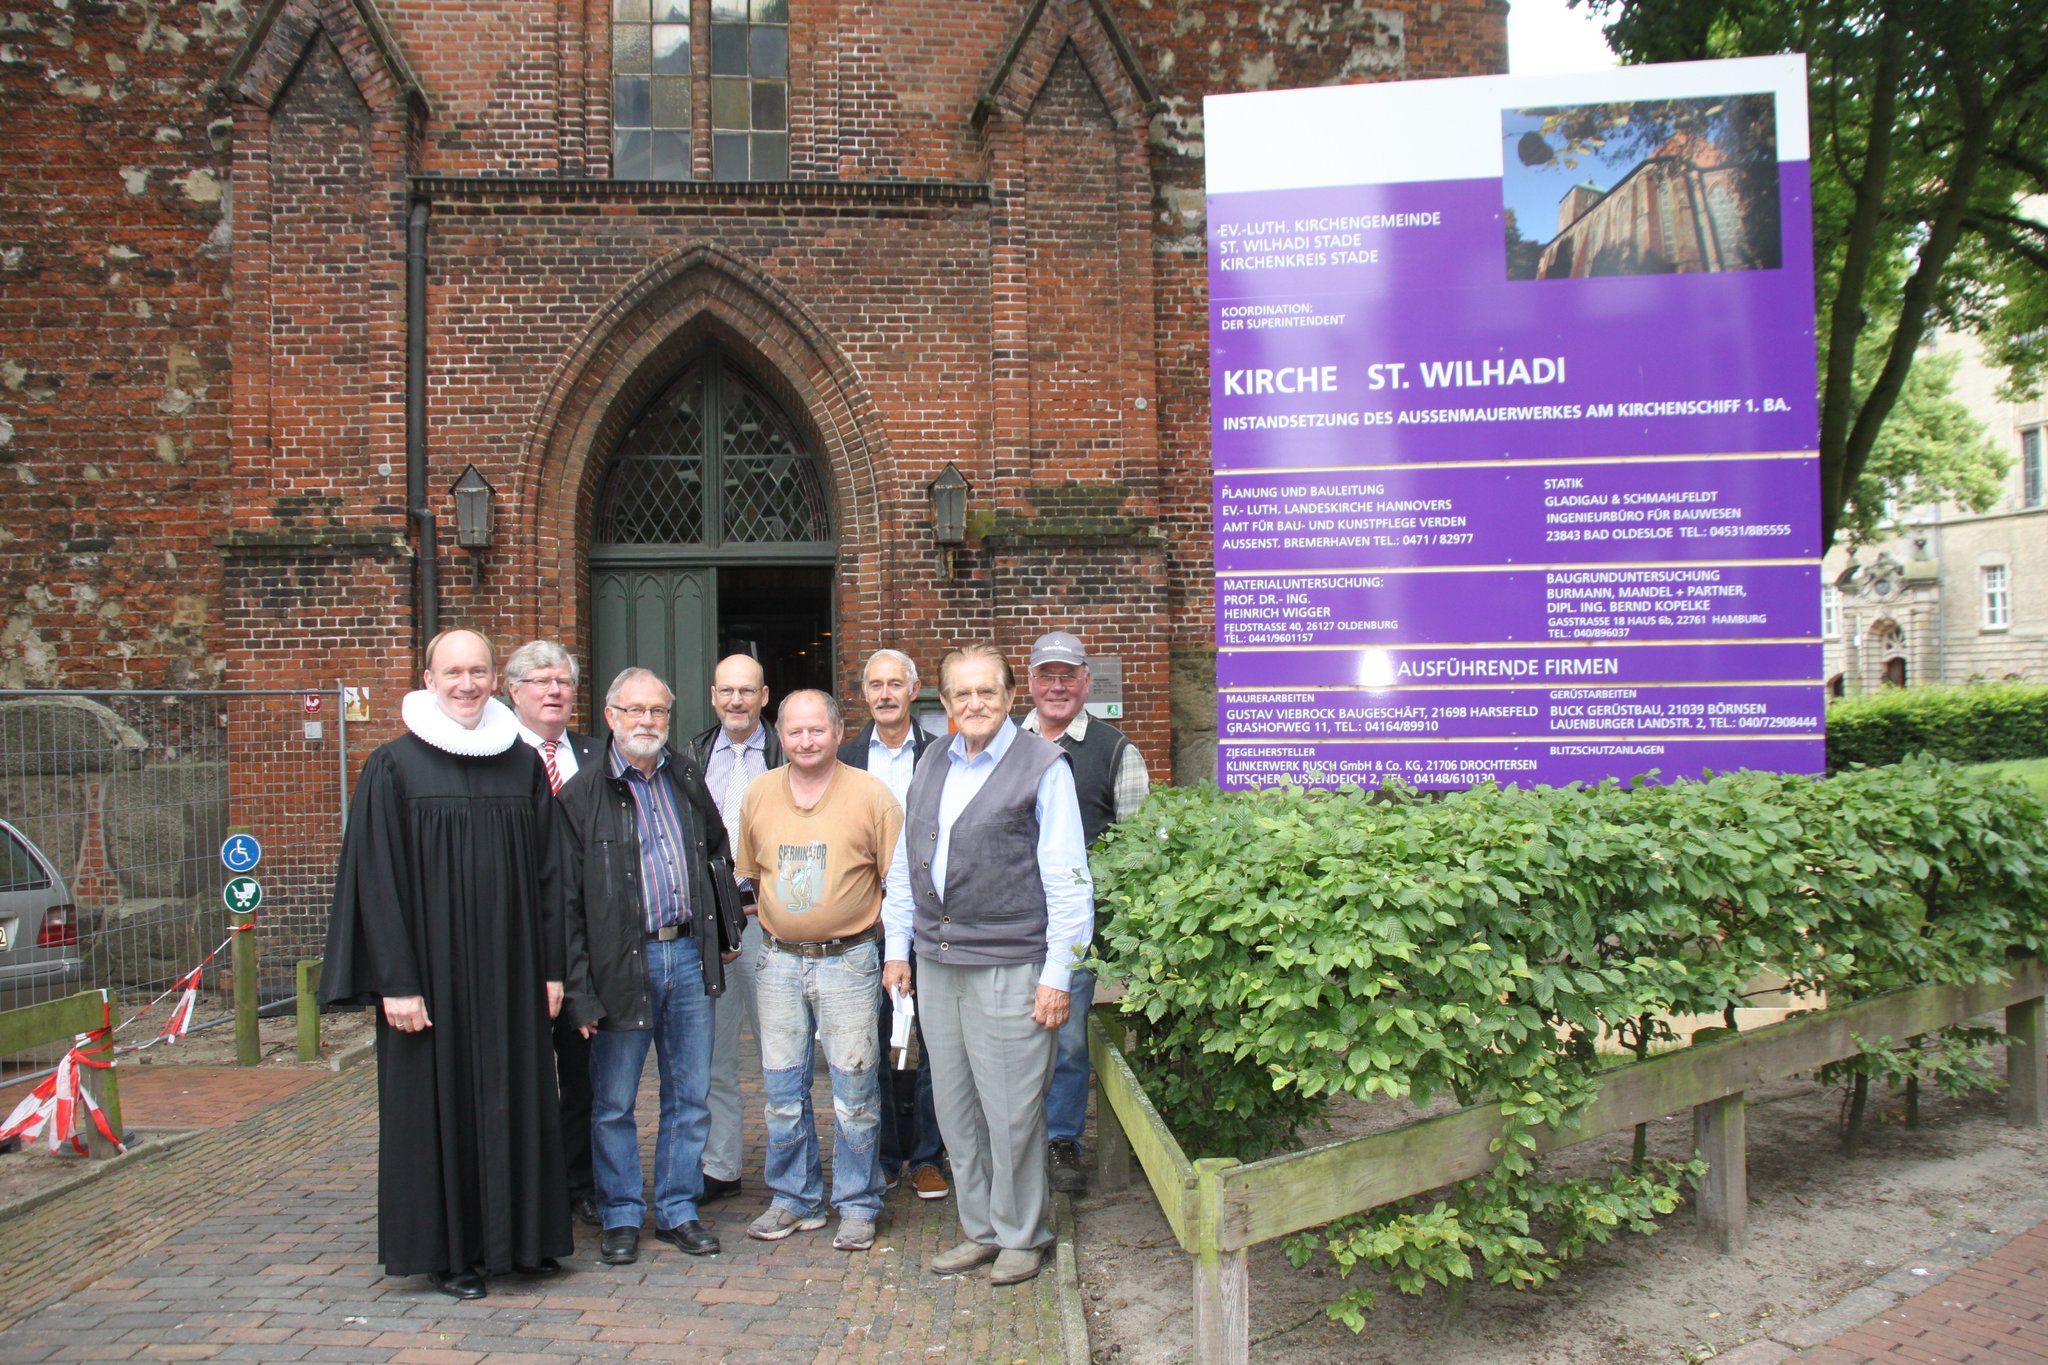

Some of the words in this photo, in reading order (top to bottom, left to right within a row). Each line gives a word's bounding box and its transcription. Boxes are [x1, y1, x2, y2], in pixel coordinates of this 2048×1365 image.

[1220, 220, 1290, 237] EV.-LUTH.
[1295, 212, 1441, 233] KIRCHENGEMEINDE
[1220, 241, 1240, 254] ST.
[1243, 237, 1309, 252] WILHADI
[1314, 233, 1361, 248] STADE
[1221, 253, 1327, 271] KIRCHENKREIS
[1331, 249, 1379, 265] STADE
[1222, 303, 1313, 317] KOORDINATION:
[1222, 319, 1244, 330] DER
[1247, 314, 1345, 329] SUPERINTENDENT
[1224, 366, 1337, 396] KIRCHE
[1367, 363, 1410, 391] ST.
[1419, 356, 1565, 388] WILHADI
[1223, 412, 1359, 430] INSTANDSETZUNG
[1364, 411, 1393, 426] DES
[1397, 404, 1582, 424] AUSSENMAUERWERKES
[1586, 404, 1613, 418] AM
[1618, 399, 1741, 417] KIRCHENSCHIFF
[1746, 399, 1759, 413] 1.
[1763, 398, 1791, 412] BA.
[1544, 478, 1584, 490] STATIK
[1222, 487, 1277, 499] PLANUNG
[1281, 487, 1307, 498] UND
[1310, 484, 1384, 496] BAULEITUNG
[1545, 495, 1608, 507] GLADIGAU
[1612, 494, 1621, 505] &
[1623, 491, 1718, 505] SCHMAHLFELDT
[1247, 504, 1281, 515] LUTH.
[1285, 501, 1373, 514] LANDESKIRCHE
[1377, 499, 1452, 512] HANNOVERS
[1546, 509, 1644, 524] INGENIEURBÜRO
[1647, 508, 1670, 521] FÜR
[1673, 508, 1742, 520] BAUWESEN
[1223, 522, 1249, 533] AMT
[1252, 519, 1274, 531] FÜR
[1277, 520, 1306, 531] BAU-
[1309, 519, 1334, 530] UND
[1338, 518, 1416, 529] KUNSTPFLEGE
[1420, 516, 1466, 528] VERDEN
[1546, 531, 1581, 542] 23843
[1584, 530, 1609, 541] BAD
[1612, 527, 1673, 539] OLDESLOE
[1680, 527, 1707, 538] TEL.:
[1710, 524, 1791, 537] 04531/885555
[1222, 538, 1281, 549] AUSSENST.
[1284, 536, 1370, 548] BREMERHAVEN
[1374, 535, 1399, 546] TEL.:
[1403, 535, 1429, 545] 0471
[1440, 533, 1473, 544] 82977
[1224, 577, 1384, 590] MATERIALUNTERSUCHUNG:
[1546, 570, 1720, 584] BAUGRUNDUNTERSUCHUNG
[1224, 595, 1256, 605] PROF.
[1286, 594, 1311, 604] ING.
[1547, 587, 1615, 600] BURMANN,
[1619, 586, 1672, 598] MANDEL
[1676, 588, 1684, 596] +
[1687, 585, 1747, 598] PARTNER,
[1224, 608, 1279, 619] HEINRICH
[1282, 607, 1331, 618] WIGGER
[1547, 602, 1577, 613] DIPL.
[1580, 601, 1607, 613] ING.
[1610, 601, 1651, 612] BERND
[1655, 600, 1710, 611] KOPELKE
[1224, 622, 1287, 632] FELDSTRASSE
[1290, 622, 1303, 632] 40,
[1306, 622, 1334, 631] 26127
[1338, 620, 1398, 630] OLDENBURG
[1548, 616, 1610, 627] GASSTRASSE
[1614, 616, 1625, 626] 18
[1627, 616, 1656, 626] HAUS
[1659, 615, 1673, 626] 6b,
[1676, 615, 1706, 625] 22761
[1712, 614, 1767, 624] HAMBURG
[1224, 634, 1246, 643] TEL.:
[1248, 633, 1313, 643] 0441/9601157
[1548, 628, 1571, 638] TEL.:
[1574, 627, 1630, 638] 040/896037
[1398, 657, 1539, 677] AUSFÜHRENDE
[1545, 658, 1618, 675] FIRMEN
[1226, 694, 1315, 703] MAURERARBEITEN
[1550, 689, 1637, 700] GERÜSTARBEITEN
[1226, 709, 1273, 720] GUSTAV
[1276, 708, 1335, 720] VIEBROCK
[1339, 706, 1428, 720] BAUGESCHÄFT,
[1431, 707, 1467, 718] 21698
[1470, 706, 1539, 718] HARSEFELD
[1550, 706, 1584, 717] BUCK
[1587, 703, 1665, 717] GERÜSTBAU,
[1668, 704, 1704, 715] 21039
[1707, 702, 1766, 715] BÖRNSEN
[1226, 721, 1311, 733] GRASHOFWEG
[1314, 722, 1331, 734] 11,
[1334, 721, 1362, 732] TEL.:
[1365, 720, 1439, 732] 04164/89910
[1550, 718, 1634, 730] LAUENBURGER
[1638, 718, 1693, 729] LANDSTR.
[1696, 718, 1707, 730] 2,
[1710, 717, 1736, 728] TEL.:
[1739, 716, 1817, 728] 040/72908444
[1226, 748, 1315, 757] ZIEGELHERSTELLER
[1550, 745, 1664, 755] BLITZSCHUTZANLAGEN
[1227, 761, 1300, 771] KLINKERWERK
[1303, 761, 1336, 771] RUSCH
[1340, 760, 1372, 771] GmbH
[1375, 761, 1383, 770] &
[1386, 761, 1402, 770] Co.
[1406, 761, 1423, 771] KG,
[1426, 760, 1457, 770] 21706
[1460, 760, 1537, 770] DROCHTERSEN
[1370, 774, 1380, 784] 2,
